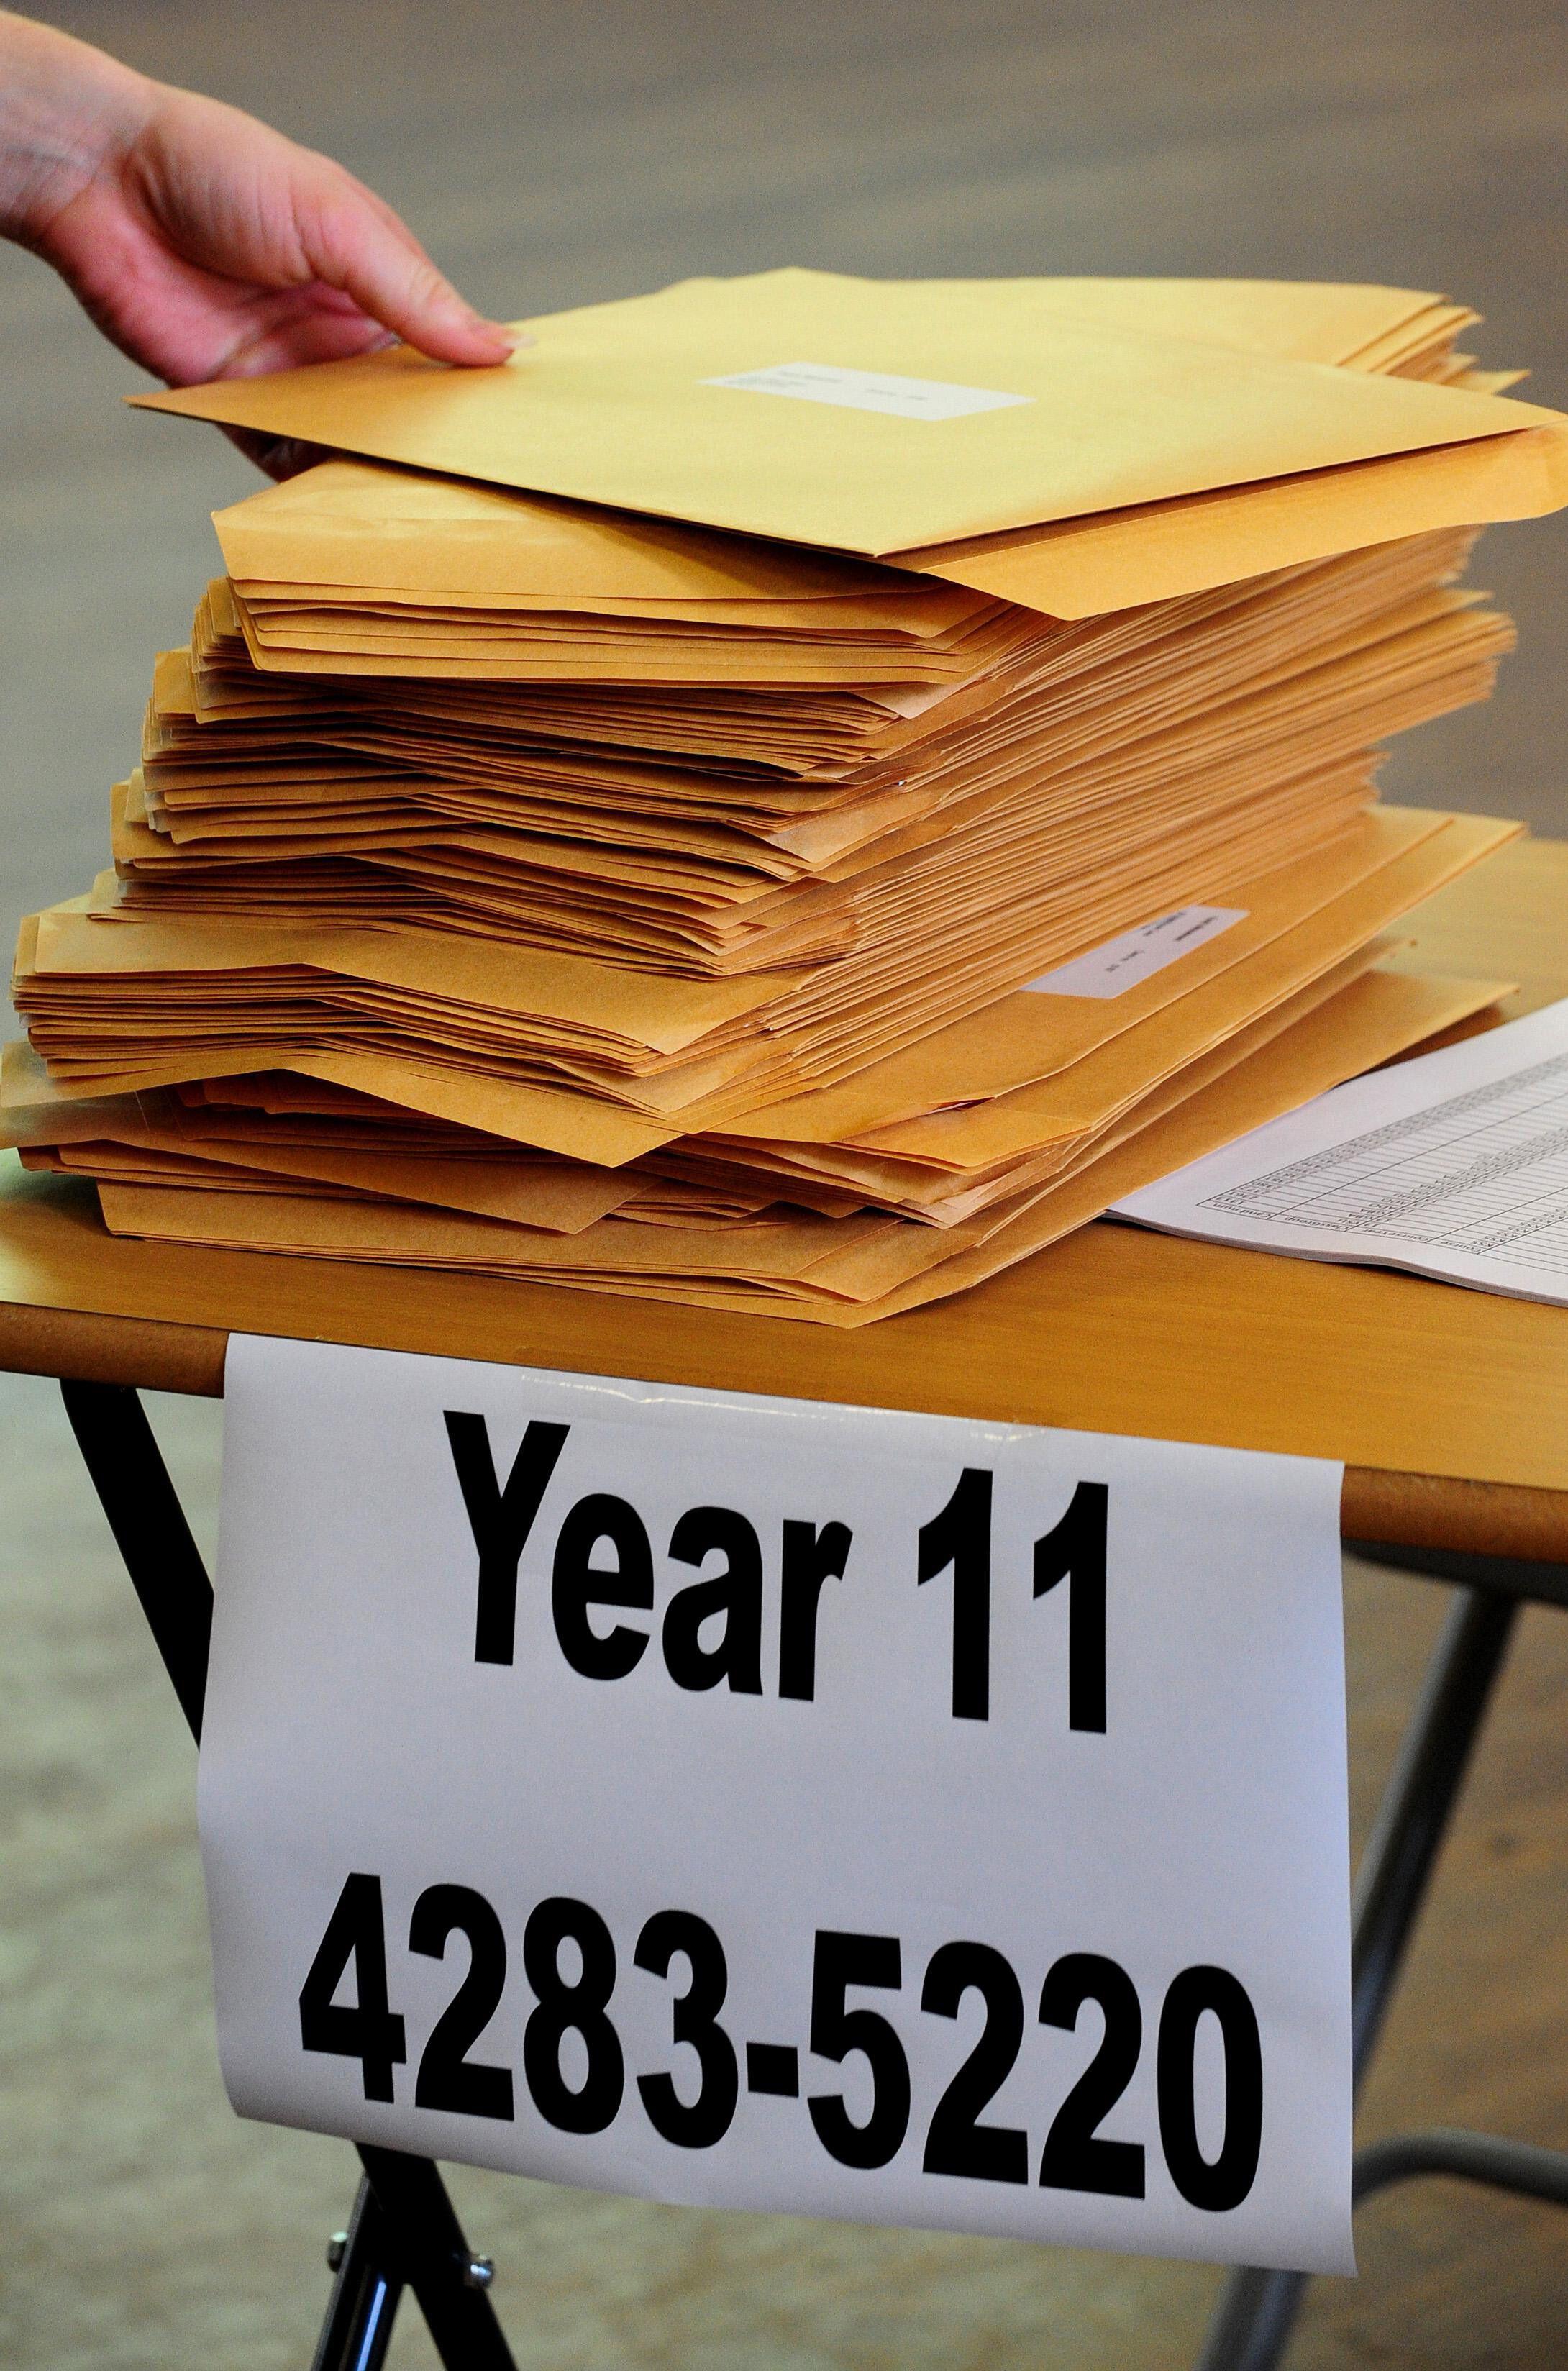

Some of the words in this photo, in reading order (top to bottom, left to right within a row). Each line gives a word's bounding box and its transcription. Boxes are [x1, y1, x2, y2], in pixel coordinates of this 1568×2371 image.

[1239, 1209, 1270, 1218] Cand
[1285, 1217, 1349, 1229] ClassGroup
[1362, 1229, 1429, 1242] CourseYear
[1440, 1242, 1482, 1252] Course
[443, 1411, 852, 1701] Year
[918, 1468, 1108, 1734] 11
[299, 1873, 1262, 2211] 4283-5220
